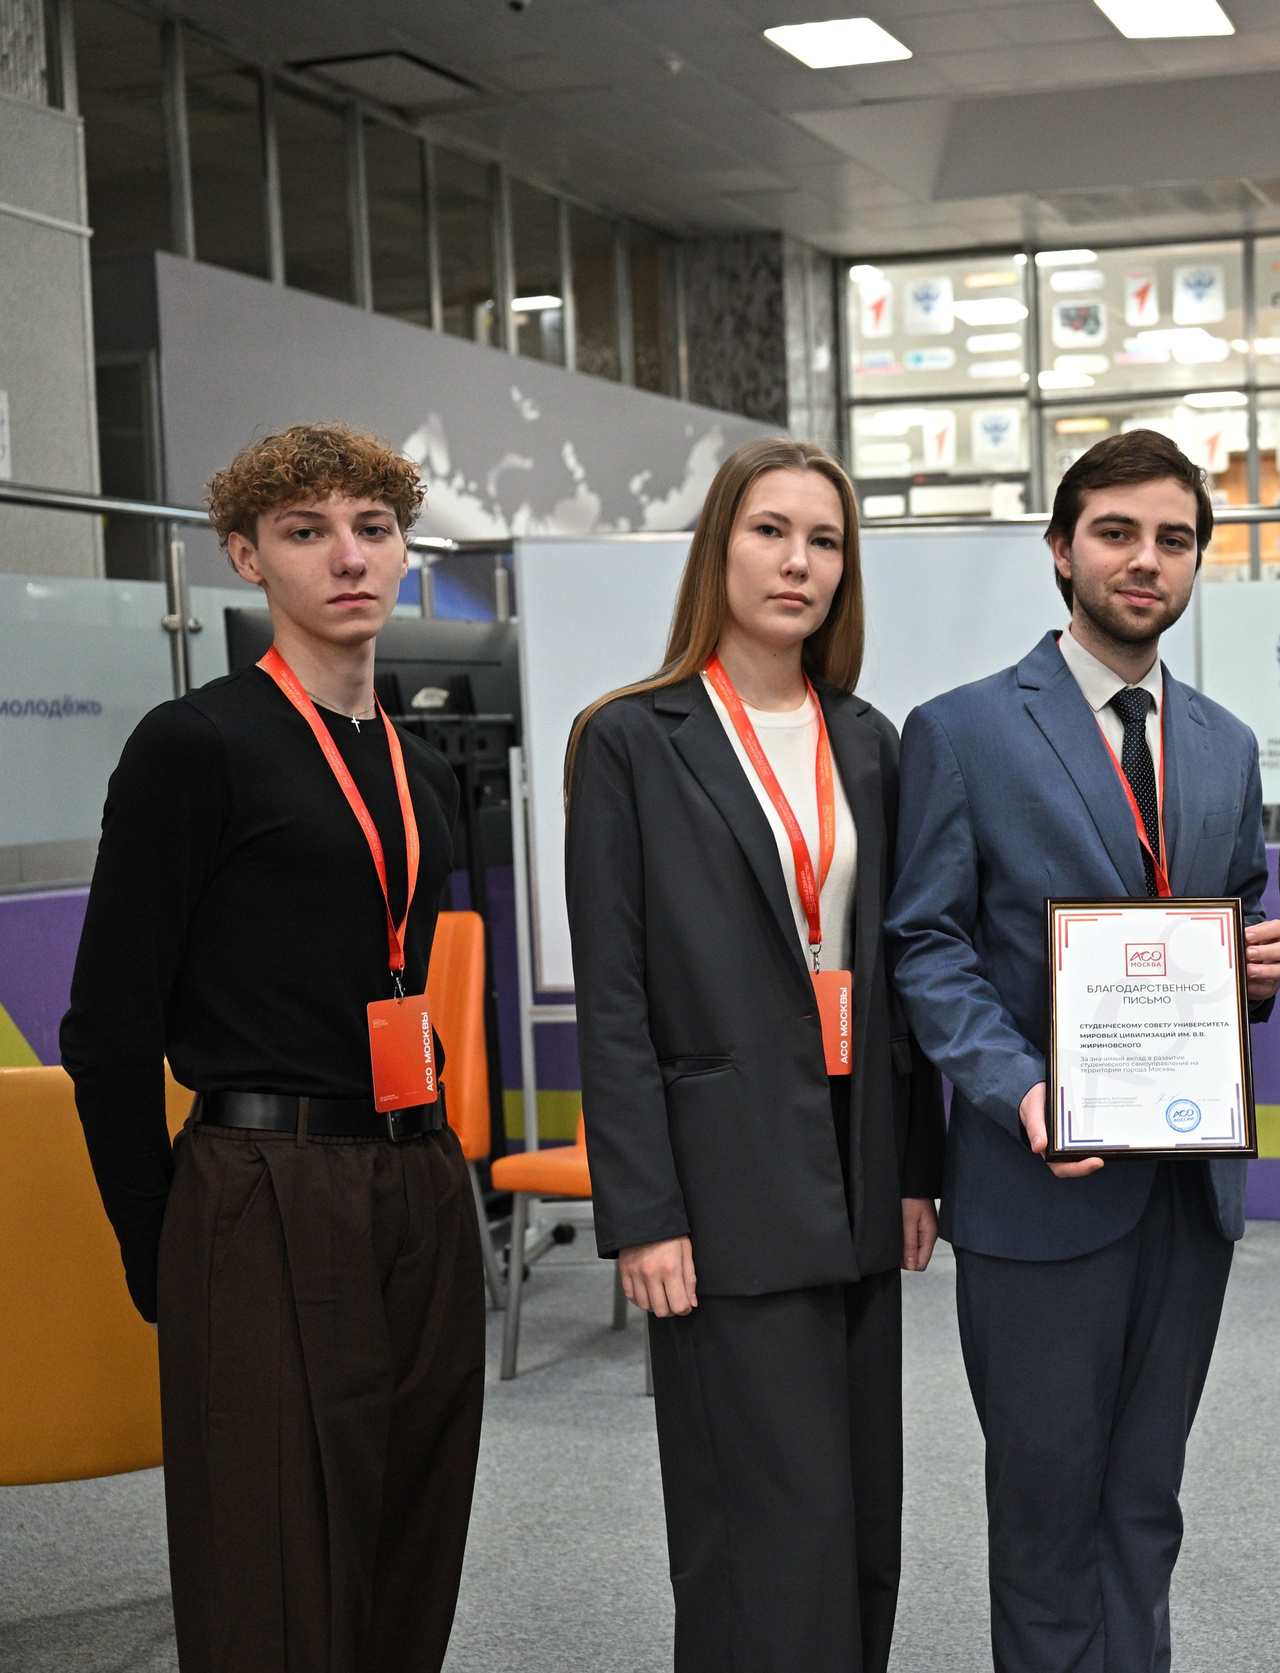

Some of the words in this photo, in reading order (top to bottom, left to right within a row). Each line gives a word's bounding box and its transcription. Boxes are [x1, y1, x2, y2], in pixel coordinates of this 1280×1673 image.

[1087, 983, 1206, 993] БЛАГОДАРСТВЕННОЕ
[1123, 996, 1172, 1004] ПИСЬМО
[839, 987, 848, 1037] МОСКВЫ
[421, 1011, 432, 1064] МОСКВЫ
[1119, 1031, 1177, 1039] ЦИВИЛИЗАЦИЙ
[840, 1040, 848, 1064] АСО
[425, 1067, 434, 1091] АСО
